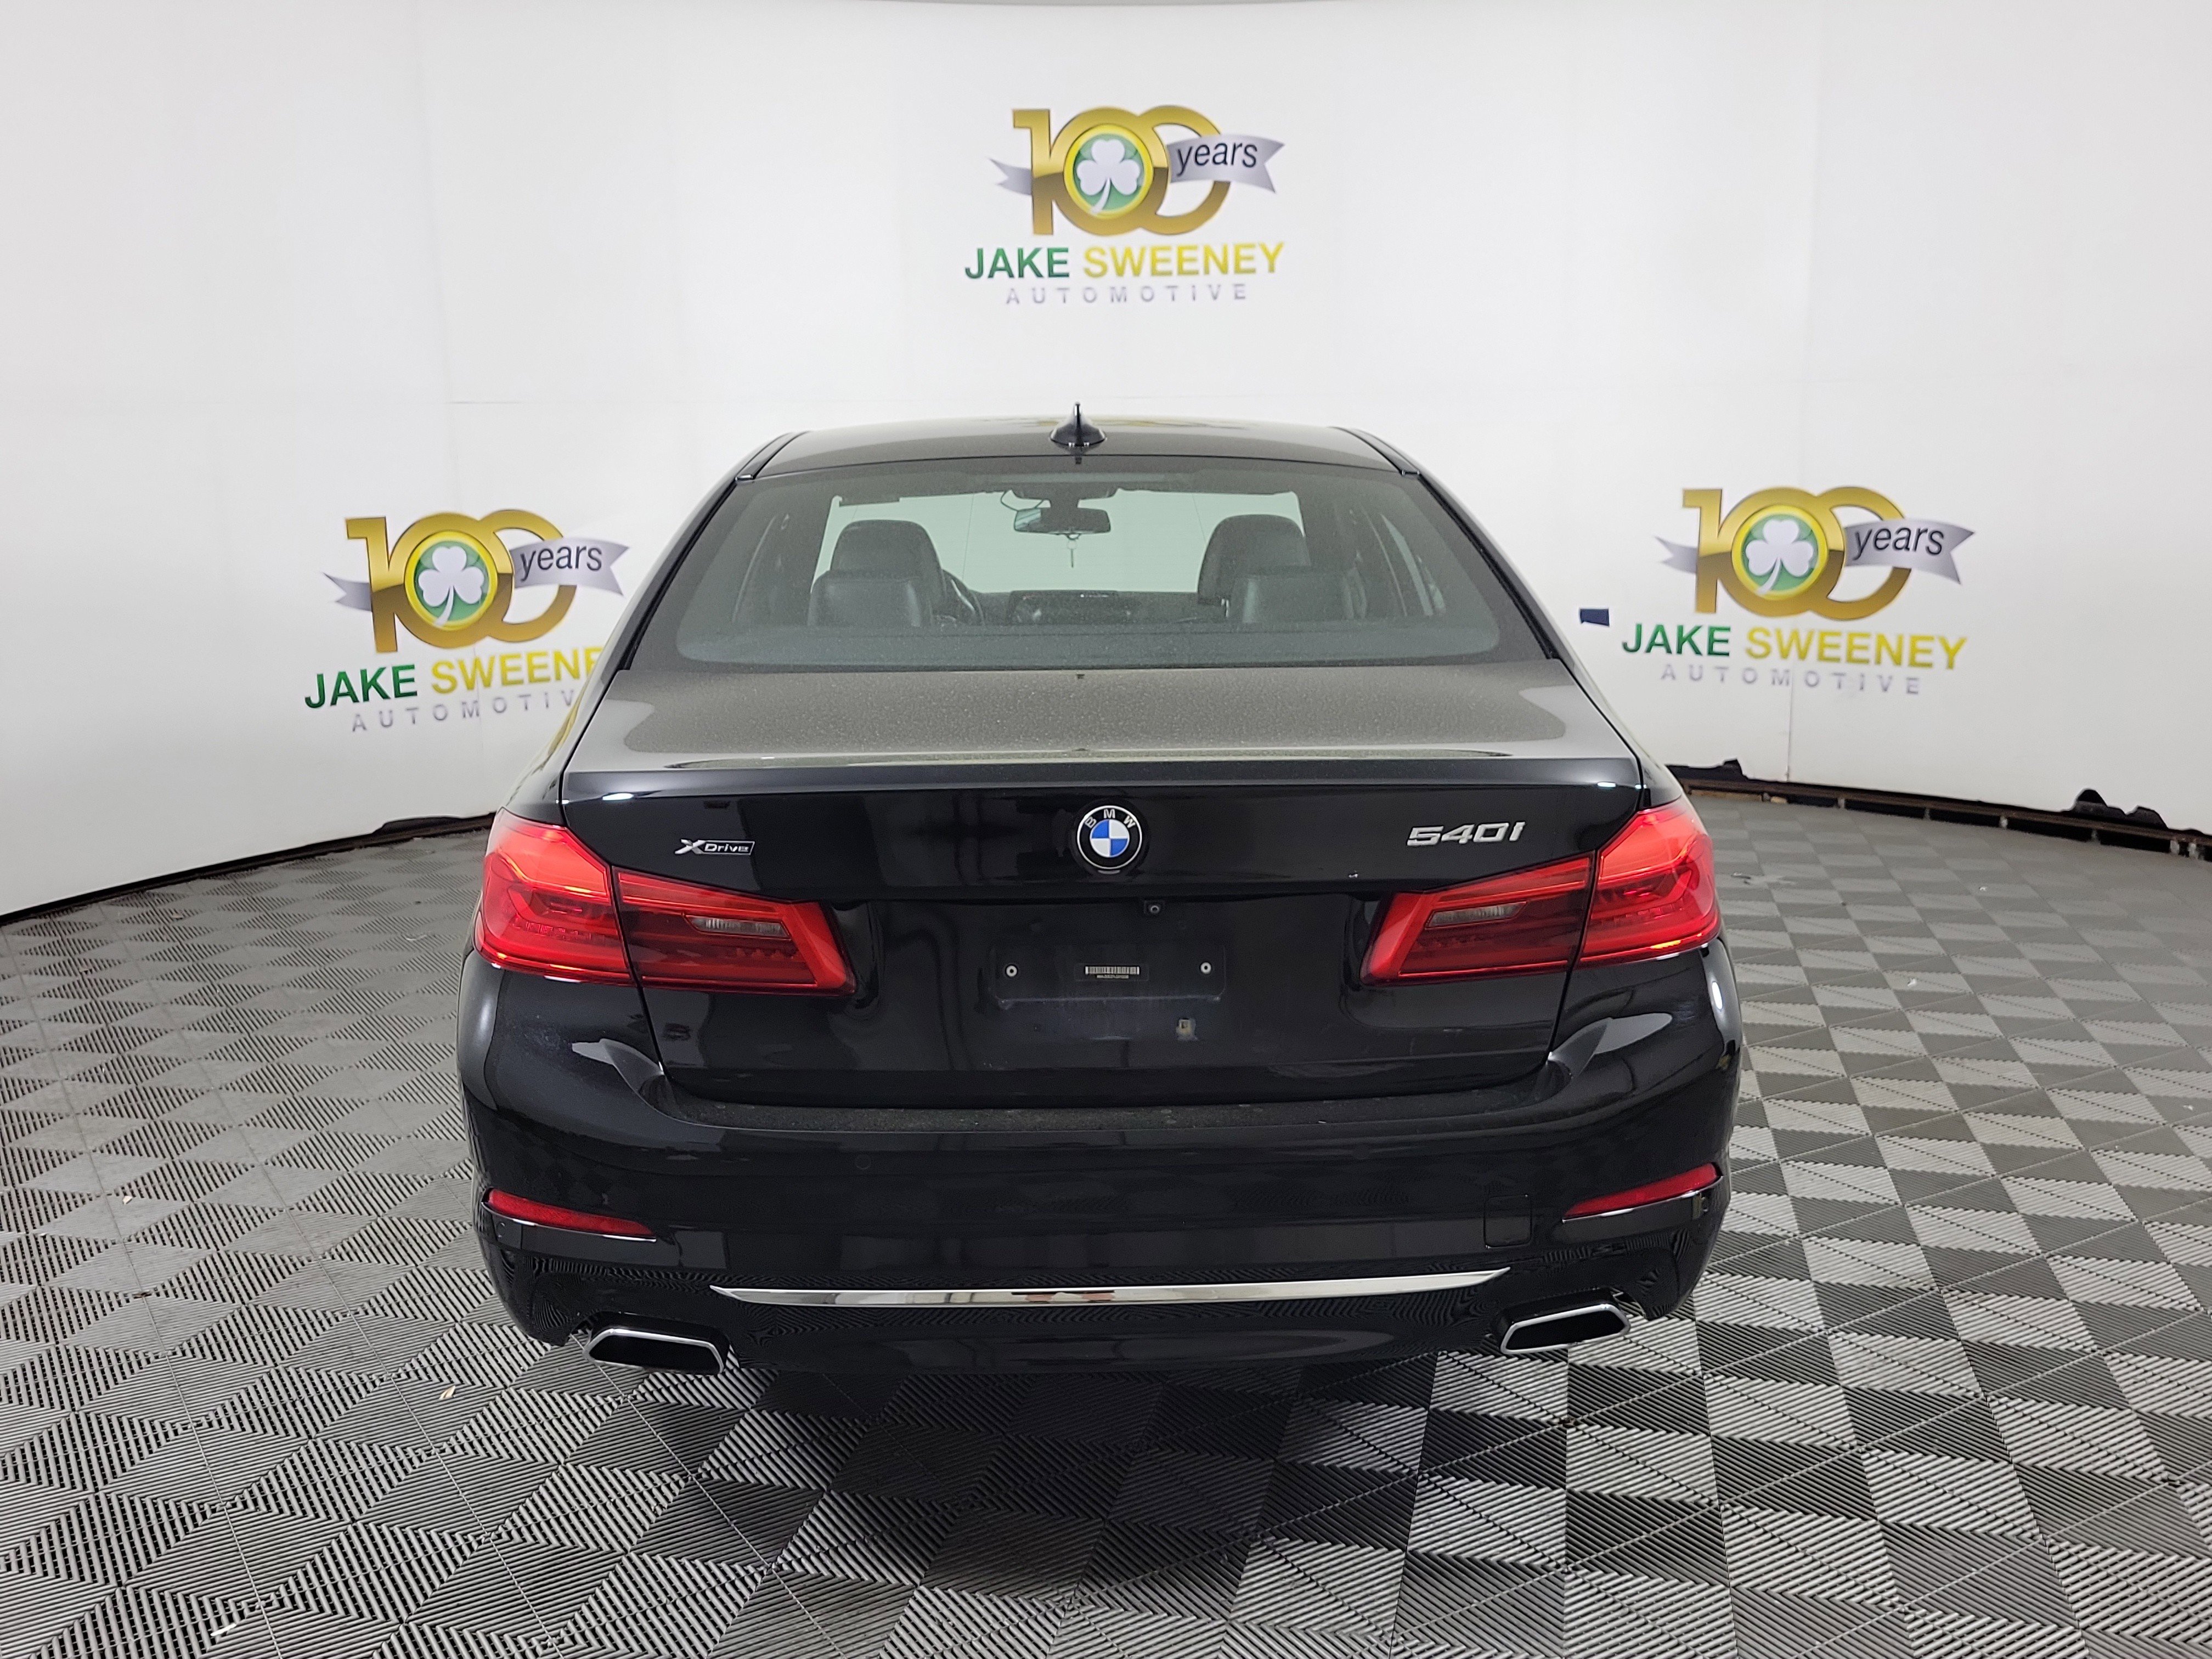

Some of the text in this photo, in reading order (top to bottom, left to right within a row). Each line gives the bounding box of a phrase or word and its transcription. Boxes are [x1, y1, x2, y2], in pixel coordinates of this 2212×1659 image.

[1012, 105, 1258, 235] 100 years
[964, 242, 1284, 279] JAKE SWEENEY
[1006, 283, 1246, 304] AUTOMOTIVE
[1682, 486, 1945, 621] 100 years
[345, 509, 602, 653] 100 years
[1622, 623, 1968, 670] JAKE SWEENEY
[304, 646, 603, 709] JAKE SWEENE
[1661, 663, 1920, 695] AUTOMOTIVE
[352, 689, 574, 733] AUTOMOTIV
[1085, 809, 1136, 829] BMW
